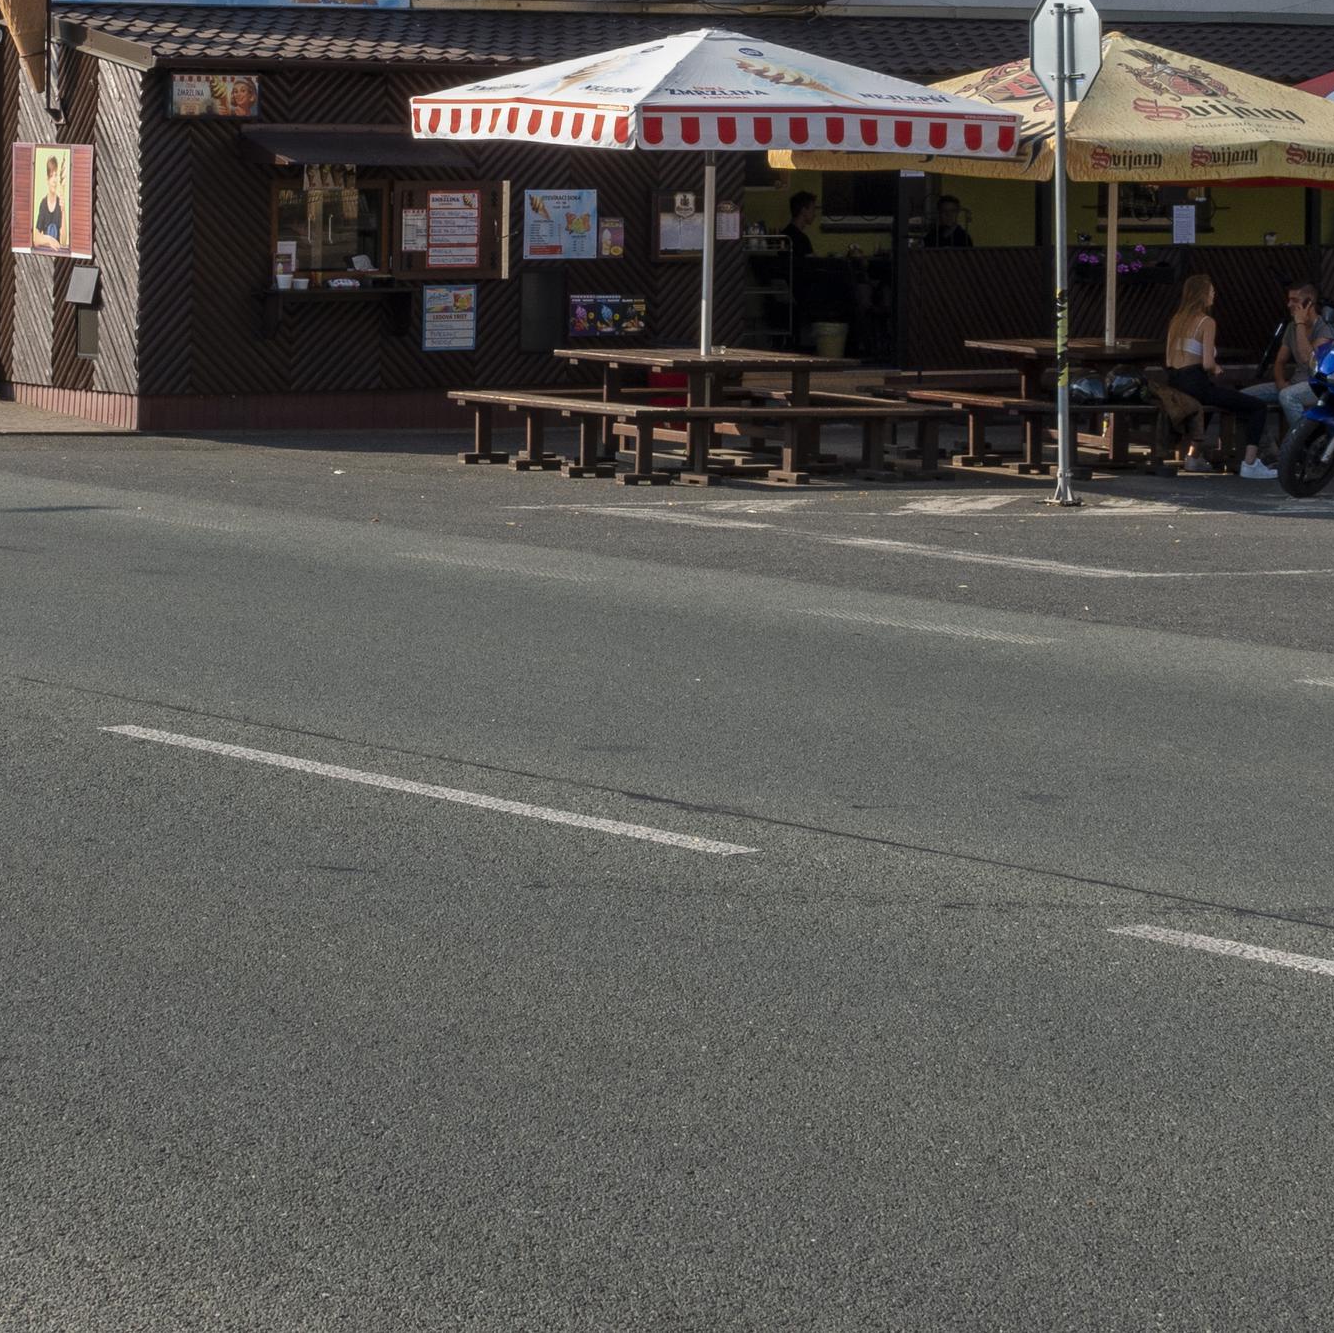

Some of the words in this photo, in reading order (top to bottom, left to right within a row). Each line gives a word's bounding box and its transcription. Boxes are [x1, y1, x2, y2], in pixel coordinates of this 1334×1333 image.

[665, 87, 770, 96] ZMRZLINA
[859, 92, 952, 104] NEJLEPŠÍ
[1132, 96, 1306, 125] Svijany
[1091, 144, 1163, 171] Svijany
[1190, 144, 1259, 169] Svijany
